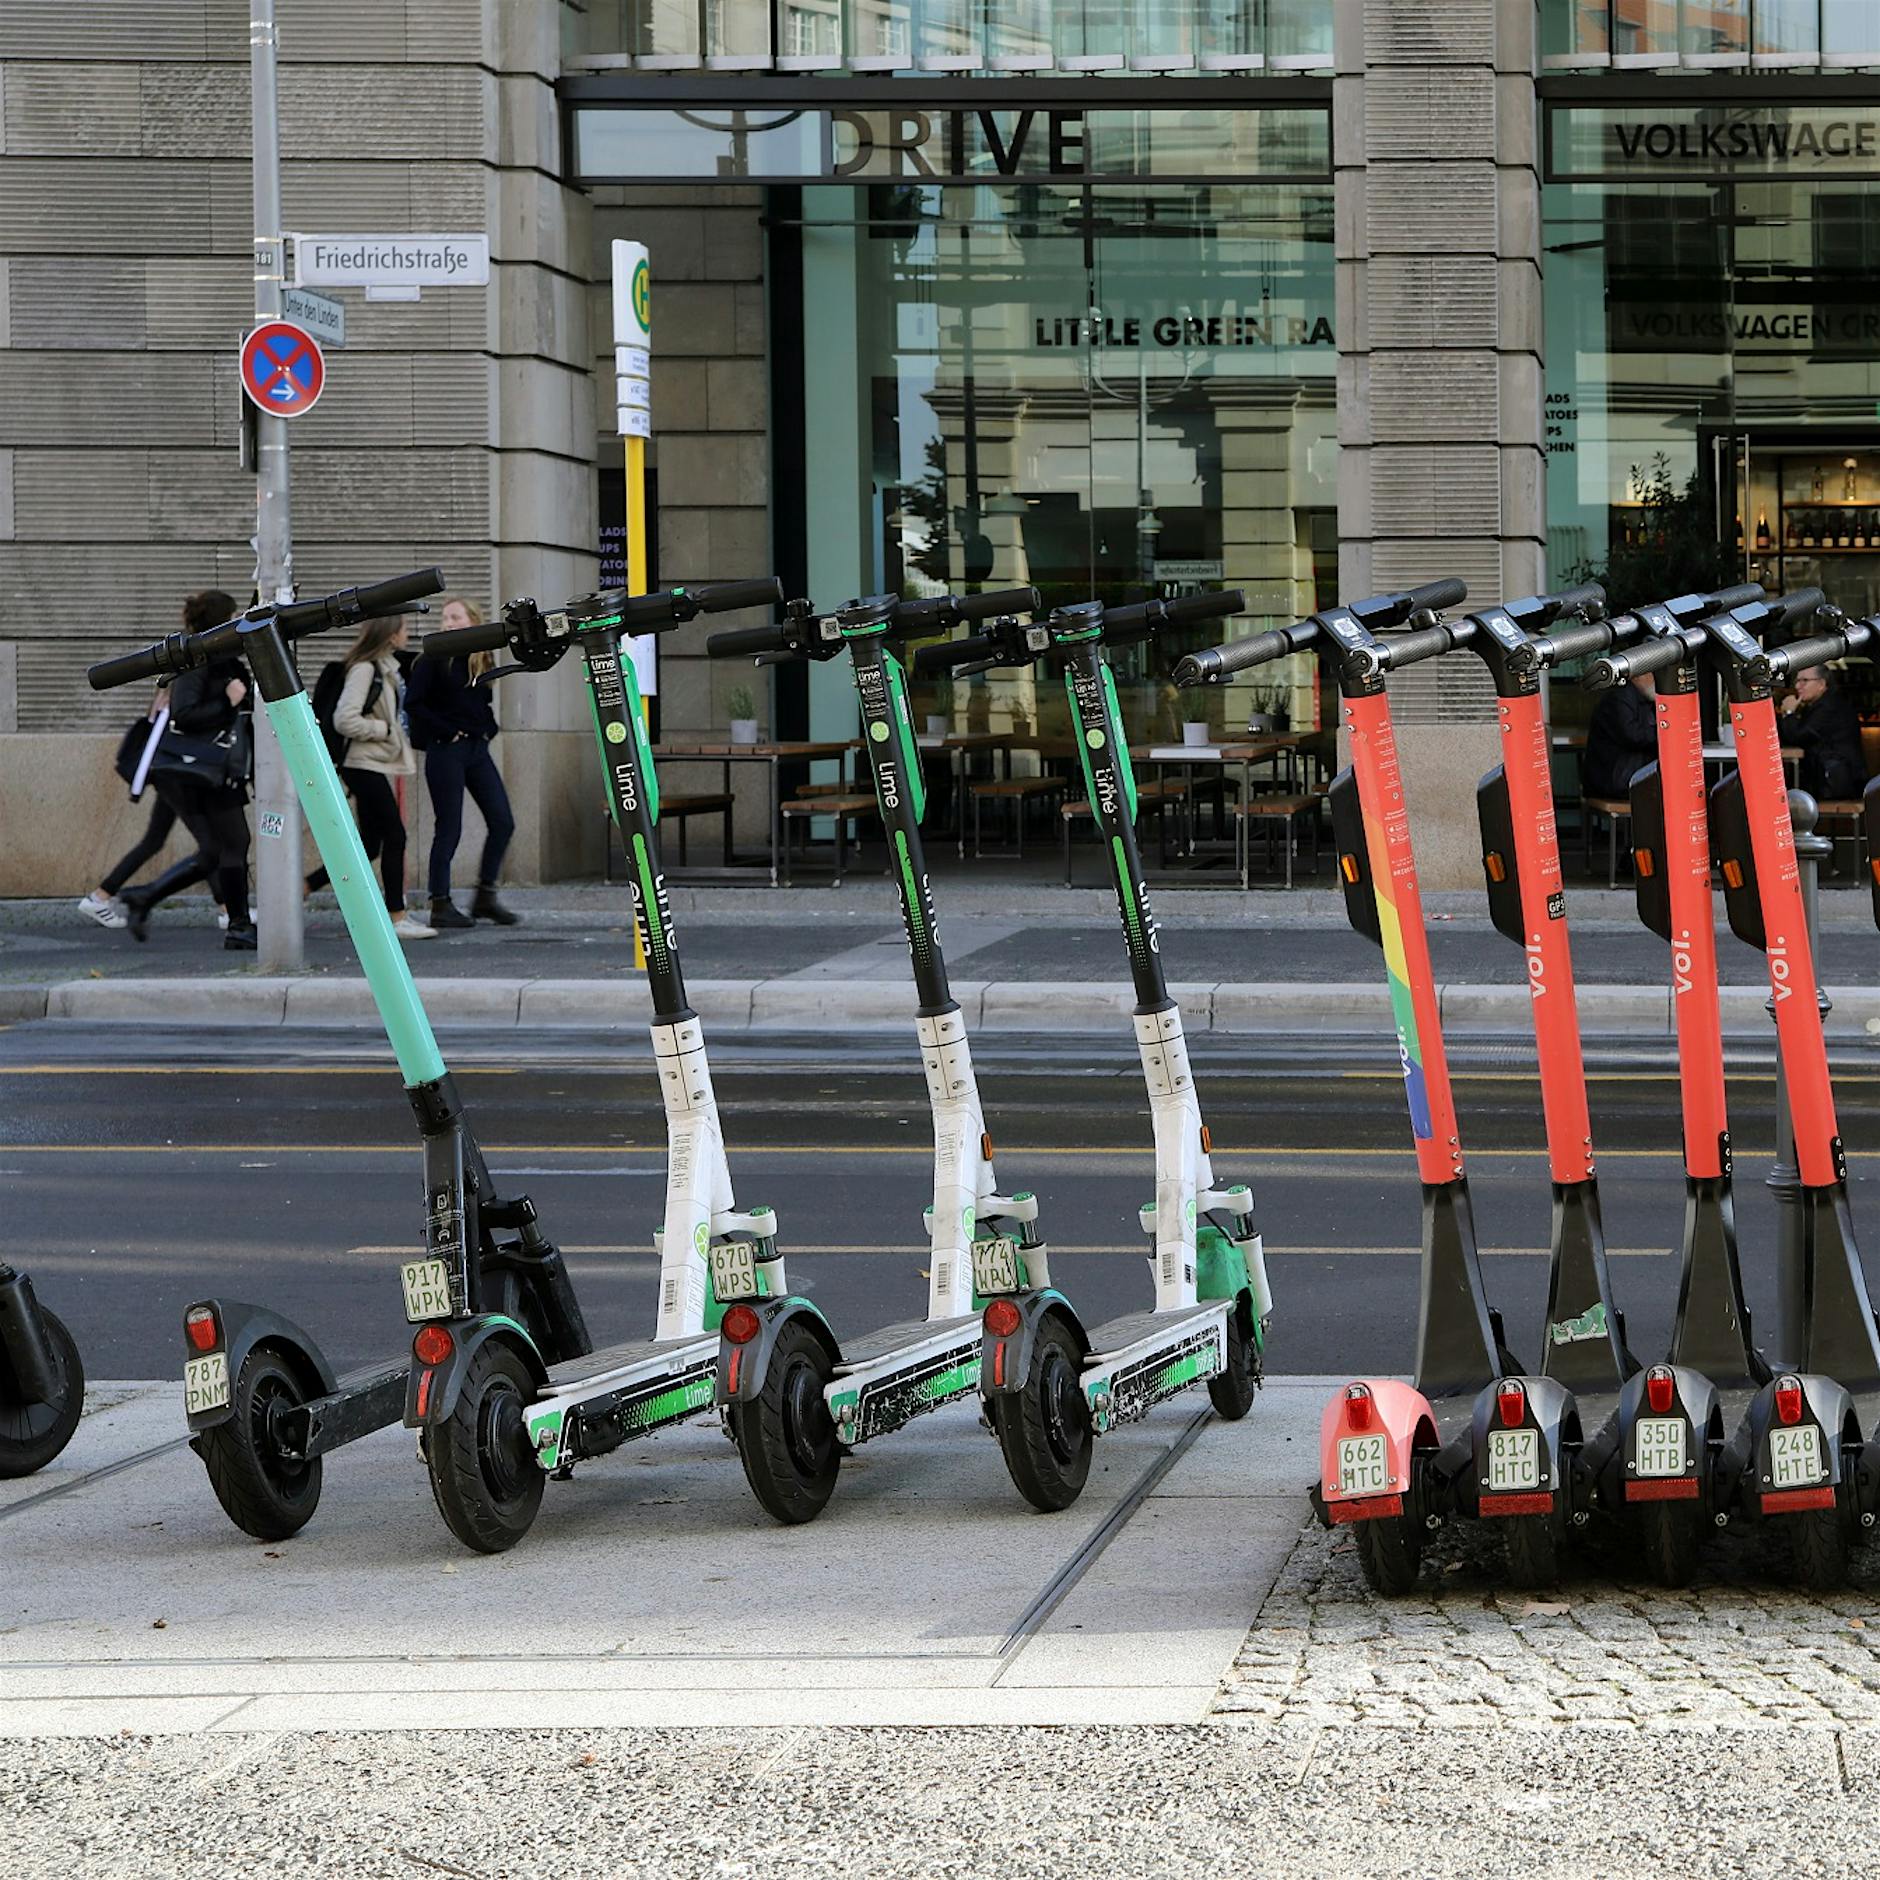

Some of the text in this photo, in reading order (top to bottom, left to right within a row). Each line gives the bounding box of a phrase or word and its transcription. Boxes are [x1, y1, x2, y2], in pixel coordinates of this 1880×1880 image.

[832, 110, 1084, 176] DRIVE
[1615, 121, 1876, 160] VOLKSWAGE
[315, 246, 468, 274] Friedrichstraße
[285, 294, 340, 329] Unter den Linden
[1153, 316, 1272, 346] GREEN
[1287, 317, 1335, 345] RA
[1631, 314, 1829, 340] VOLKSWAGEN
[1545, 394, 1570, 404] ADS
[599, 559, 627, 569] ATO
[615, 762, 638, 812] Lime
[878, 761, 900, 810] Lime
[716, 1246, 748, 1269] 670
[407, 1263, 440, 1289] 917
[717, 1271, 752, 1295] WPS
[410, 1289, 446, 1315] WPK
[188, 1358, 221, 1386] 787
[189, 1382, 225, 1411] PNM
[685, 1386, 712, 1409] Lime
[1495, 1434, 1531, 1457] 817
[1642, 1423, 1679, 1445] 350
[1776, 1430, 1813, 1456] 248
[1344, 1440, 1381, 1463] 662
[1641, 1448, 1680, 1470] HTB
[1343, 1465, 1383, 1490] HTC
[1494, 1460, 1533, 1484] HTC
[1778, 1457, 1817, 1482] HTE
